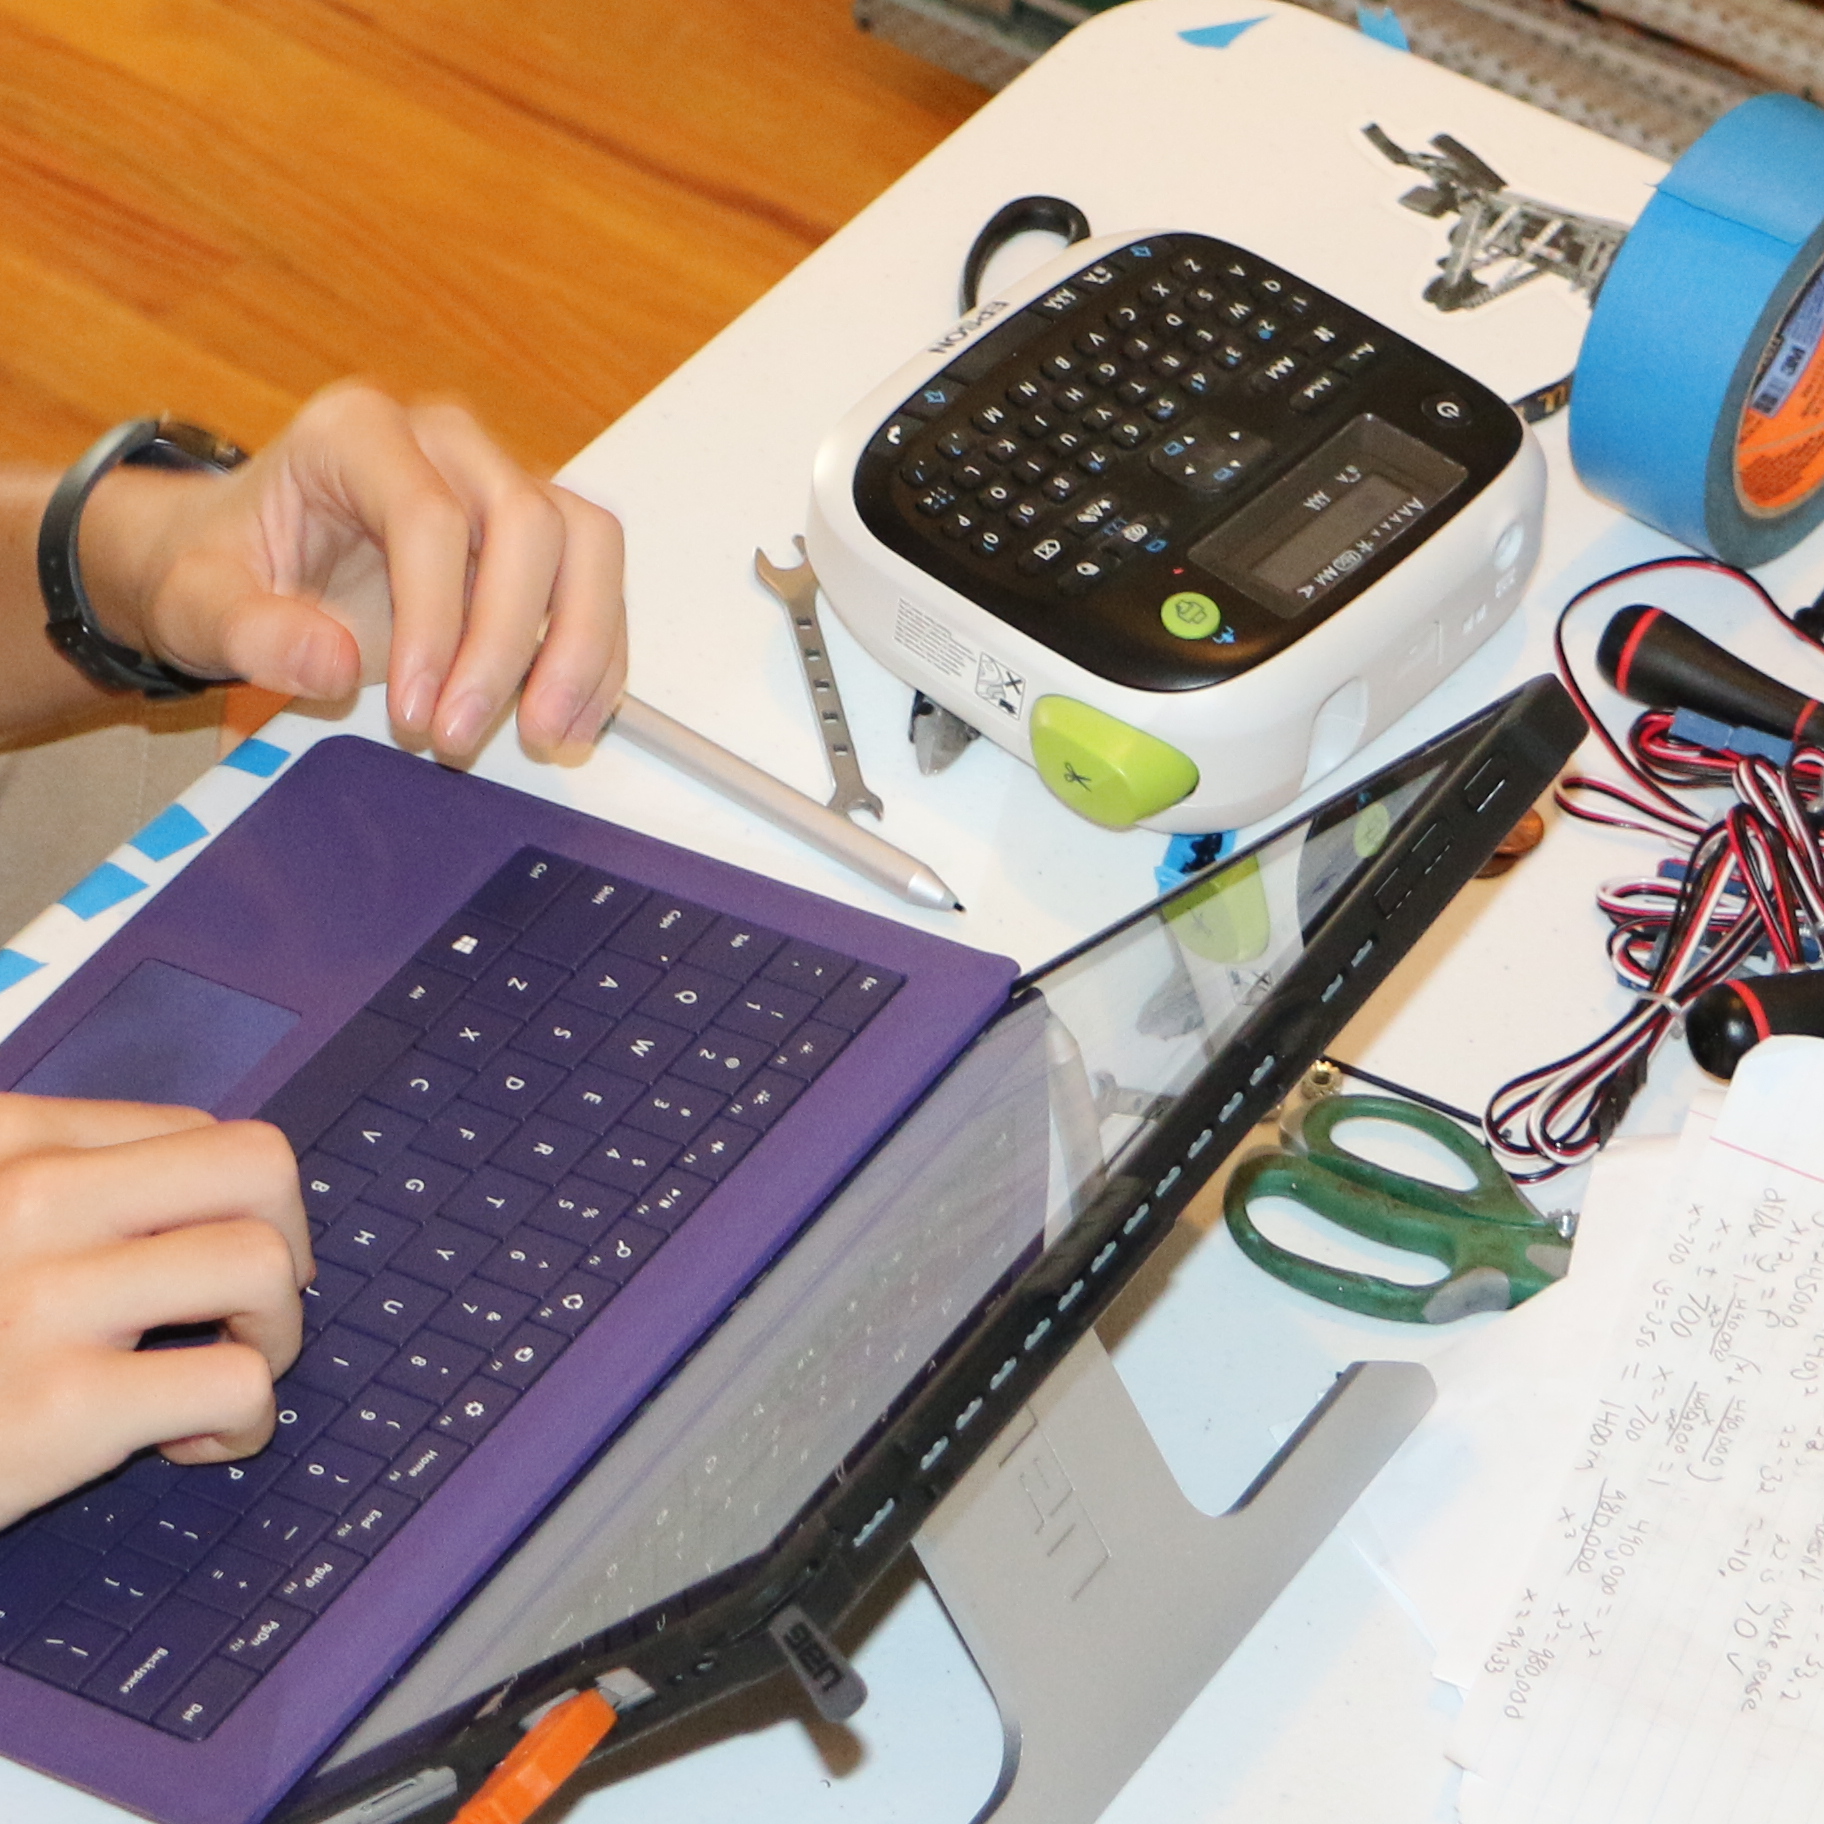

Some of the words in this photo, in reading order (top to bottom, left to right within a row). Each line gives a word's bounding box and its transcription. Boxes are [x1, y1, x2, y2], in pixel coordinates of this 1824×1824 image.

[1229, 264, 1245, 277] A
[1152, 282, 1170, 297] X
[1197, 289, 1214, 301] S
[1120, 307, 1136, 321] C
[1229, 302, 1250, 319] W
[1089, 332, 1105, 346] V
[1197, 329, 1213, 342] E
[1784, 346, 1806, 375] 3M
[1019, 381, 1037, 397] N
[1066, 388, 1084, 401] H
[1130, 382, 1146, 394] T
[983, 406, 1004, 424] M
[1096, 408, 1112, 420] Y
[998, 439, 1016, 453] K
[1059, 433, 1077, 447] U
[964, 465, 981, 476] L
[957, 514, 971, 527] P
[507, 977, 528, 991] Z
[599, 975, 618, 988] A
[674, 990, 698, 1004] Q
[459, 1027, 481, 1042] X
[553, 1027, 572, 1039] S
[630, 1039, 655, 1057] W
[410, 1078, 430, 1092] C
[505, 1076, 525, 1091] D
[583, 1091, 602, 1104] E
[362, 1130, 382, 1144] V
[459, 1128, 476, 1141] F
[533, 1142, 554, 1156] R
[310, 1180, 330, 1193] B
[405, 1178, 425, 1193] G
[486, 1196, 505, 1209] T
[354, 1230, 376, 1246] H
[436, 1249, 455, 1261] Y
[383, 1300, 404, 1315] U
[333, 1357, 349, 1367] I
[278, 1409, 298, 1425] O
[408, 1449, 438, 1477] Home
[228, 1466, 244, 1480] P
[360, 1509, 383, 1530] End
[305, 1562, 333, 1588] PgUp
[251, 1620, 280, 1646] PgDn
[120, 1647, 169, 1694] Backspace
[182, 1703, 203, 1722] Del
